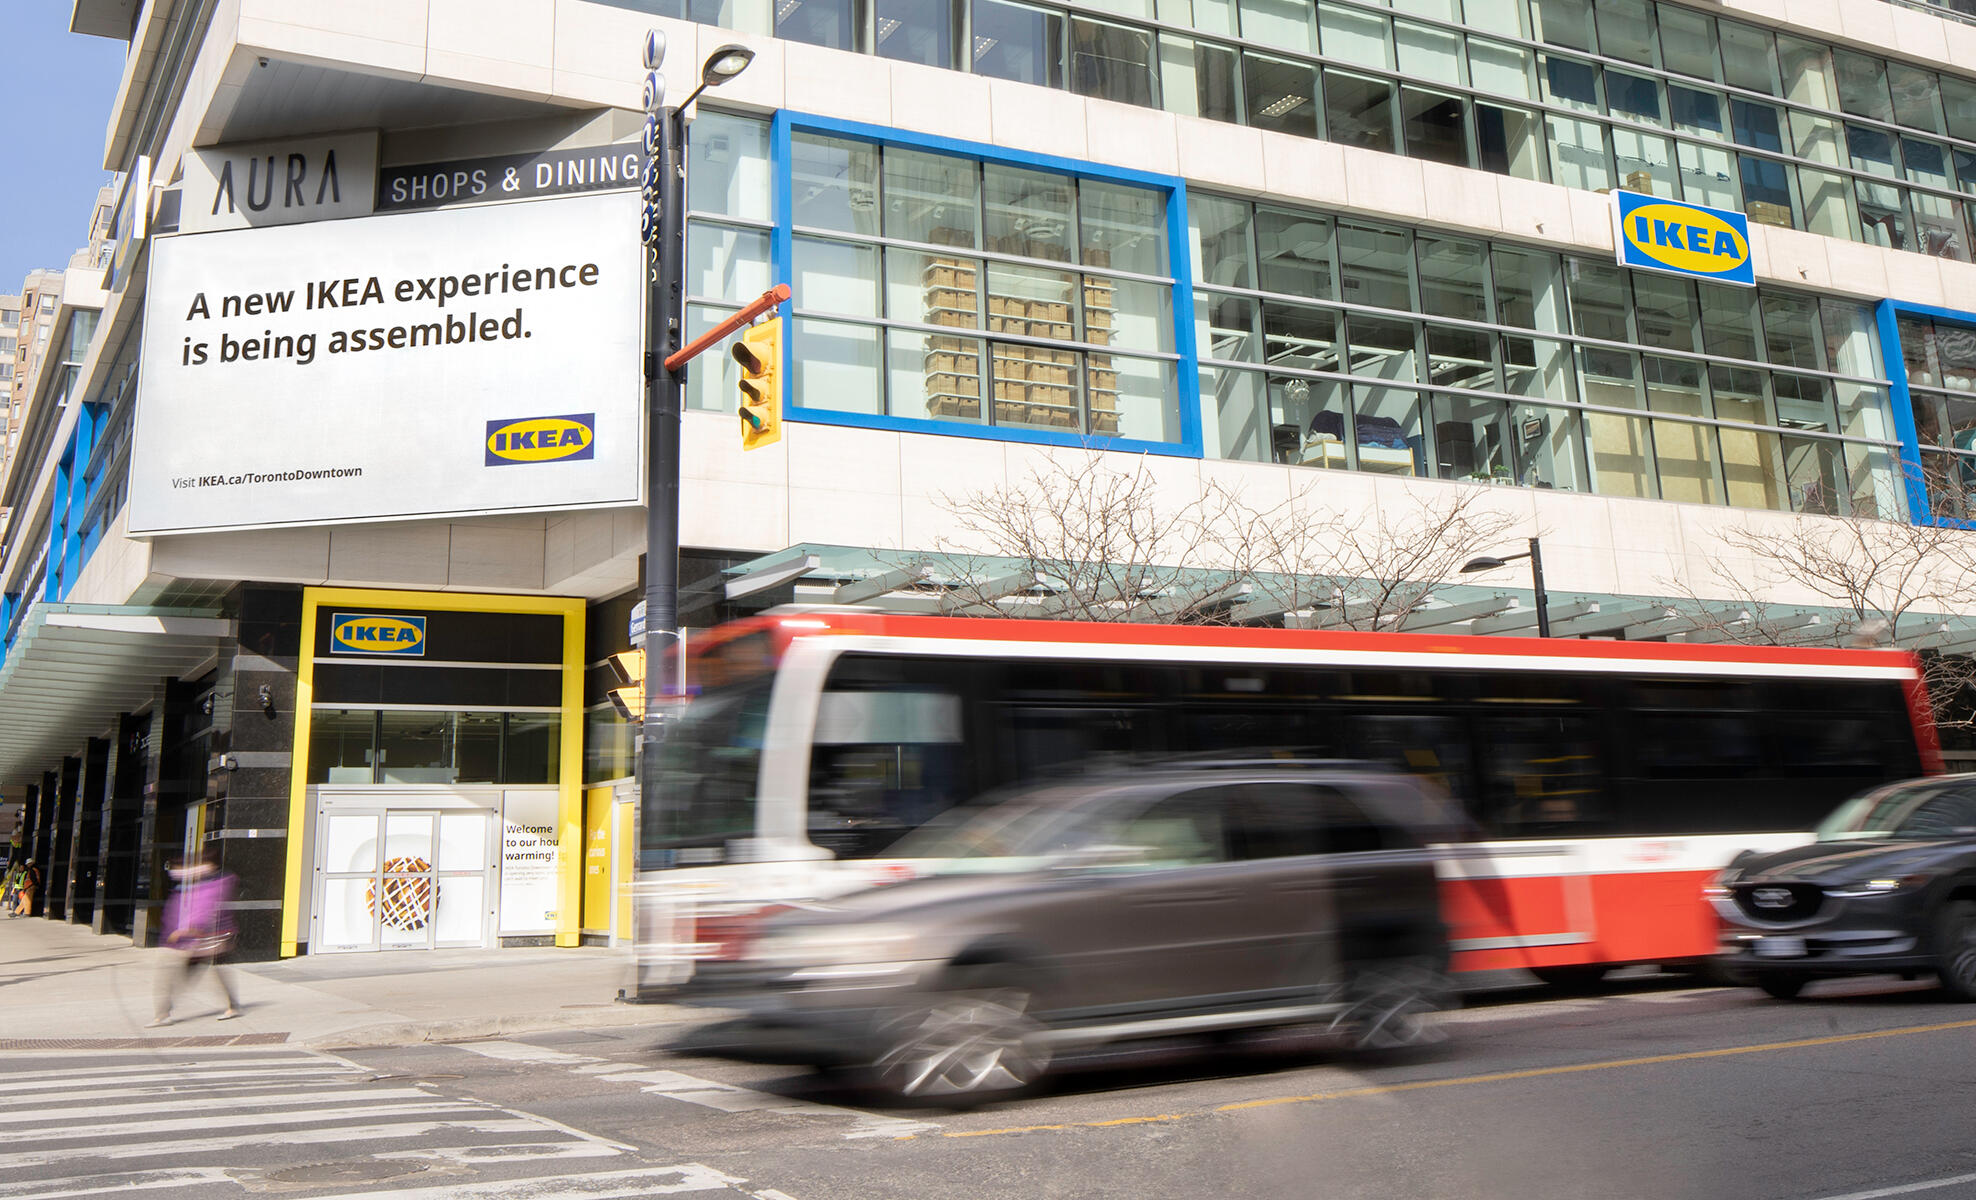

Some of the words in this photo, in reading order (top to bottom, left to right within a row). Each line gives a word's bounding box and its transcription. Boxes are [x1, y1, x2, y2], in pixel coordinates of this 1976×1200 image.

[211, 149, 340, 215] AURA
[391, 169, 487, 202] SHOPS
[502, 166, 520, 192] &
[536, 154, 639, 189] DINING
[1634, 215, 1741, 260] IKEA
[187, 292, 210, 320] A
[222, 287, 294, 318] new
[306, 277, 385, 310] IKEA
[394, 262, 600, 306] experience
[182, 337, 209, 366] is
[220, 331, 317, 365] being
[328, 309, 532, 354] assembled.
[495, 428, 584, 451] IKEA
[172, 477, 196, 489] Visit
[198, 467, 363, 487] IKEA.ca/TorontoDowntown
[343, 626, 416, 643] IKEA
[506, 824, 553, 834] Welcome
[506, 839, 517, 847] to
[519, 839, 537, 847] our
[505, 851, 555, 862] warming!
